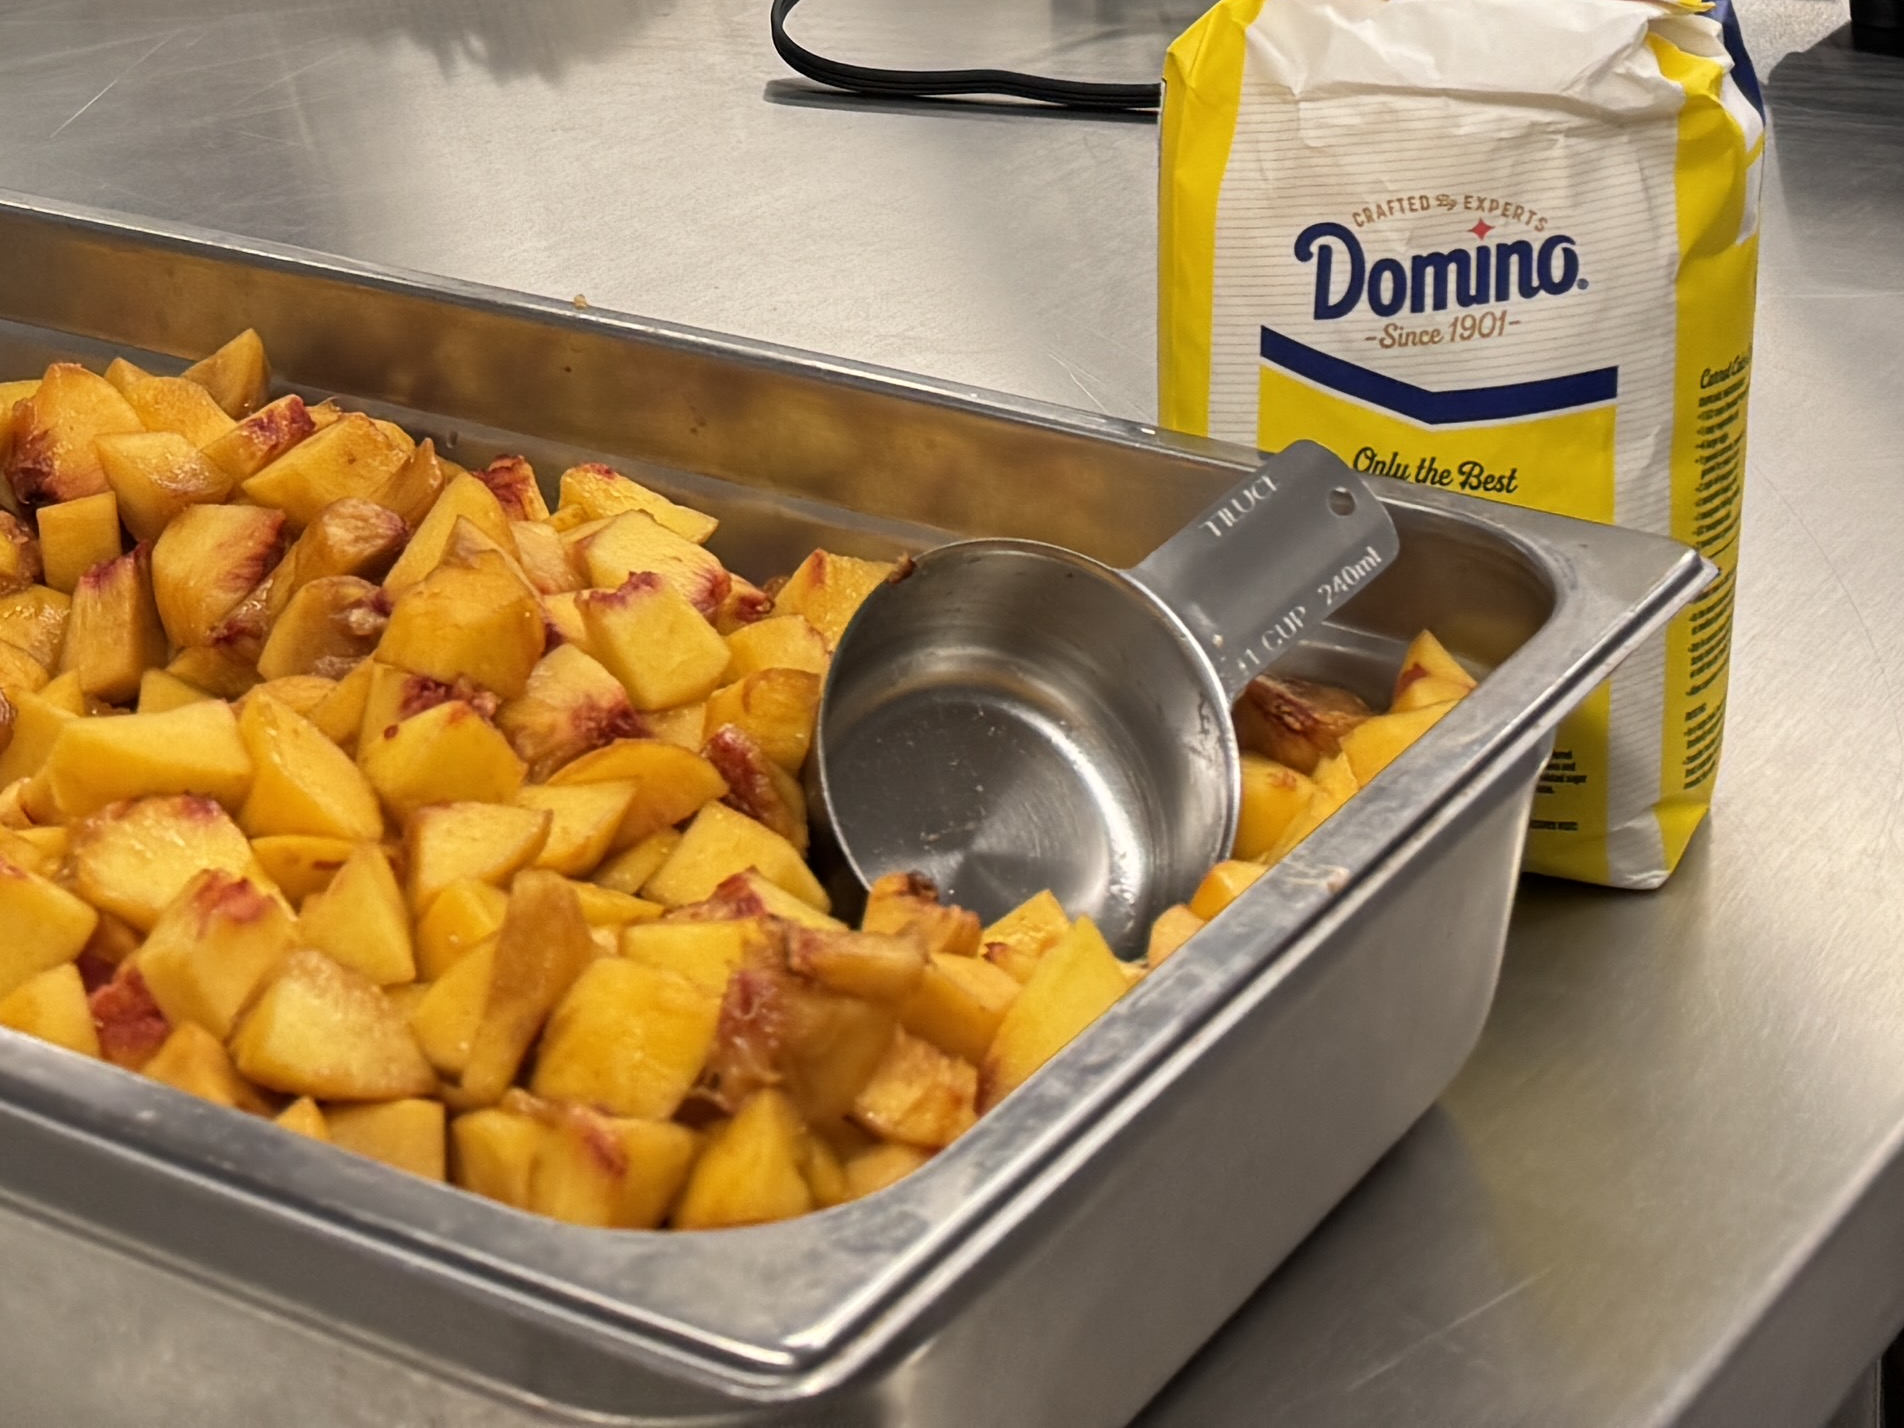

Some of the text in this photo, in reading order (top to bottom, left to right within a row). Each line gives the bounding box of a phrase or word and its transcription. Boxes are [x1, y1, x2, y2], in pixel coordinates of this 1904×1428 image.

[1352, 194, 1431, 228] CRAFTED
[1464, 195, 1549, 233] EXPERTS
[1294, 222, 1580, 321] Domino
[1353, 446, 1519, 494] Only the Best
[1261, 605, 1306, 651] CUP
[1317, 545, 1383, 606] 240ml
